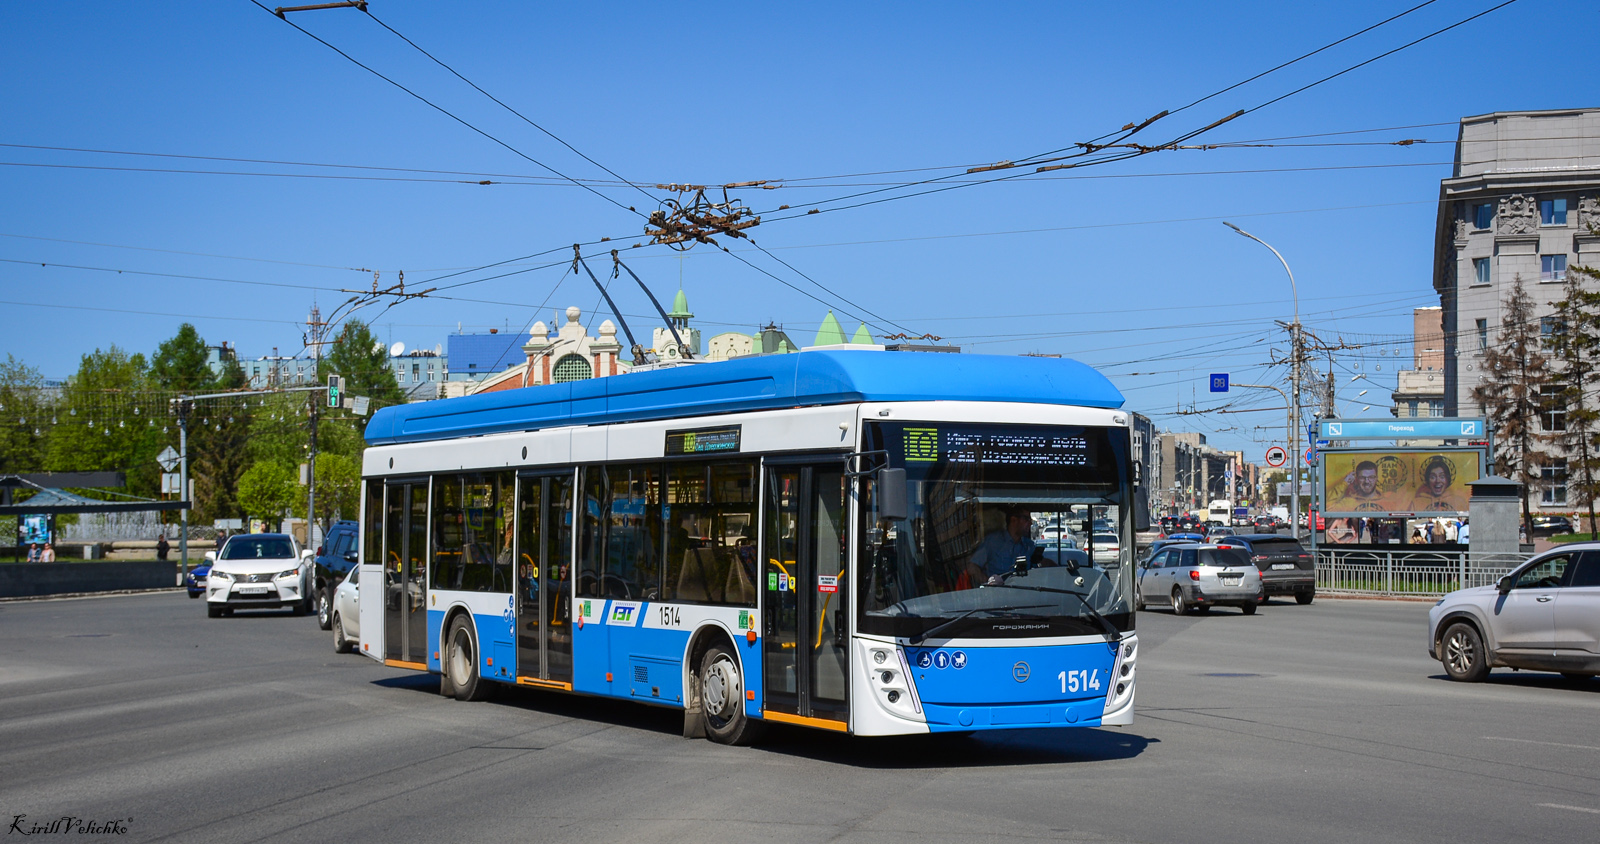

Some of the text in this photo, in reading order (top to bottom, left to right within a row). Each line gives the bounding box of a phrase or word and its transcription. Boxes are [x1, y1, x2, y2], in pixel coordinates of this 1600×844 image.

[903, 431, 934, 459] 10
[1382, 469, 1398, 478] 30
[659, 606, 681, 626] 1514
[1058, 668, 1100, 693] 1514
